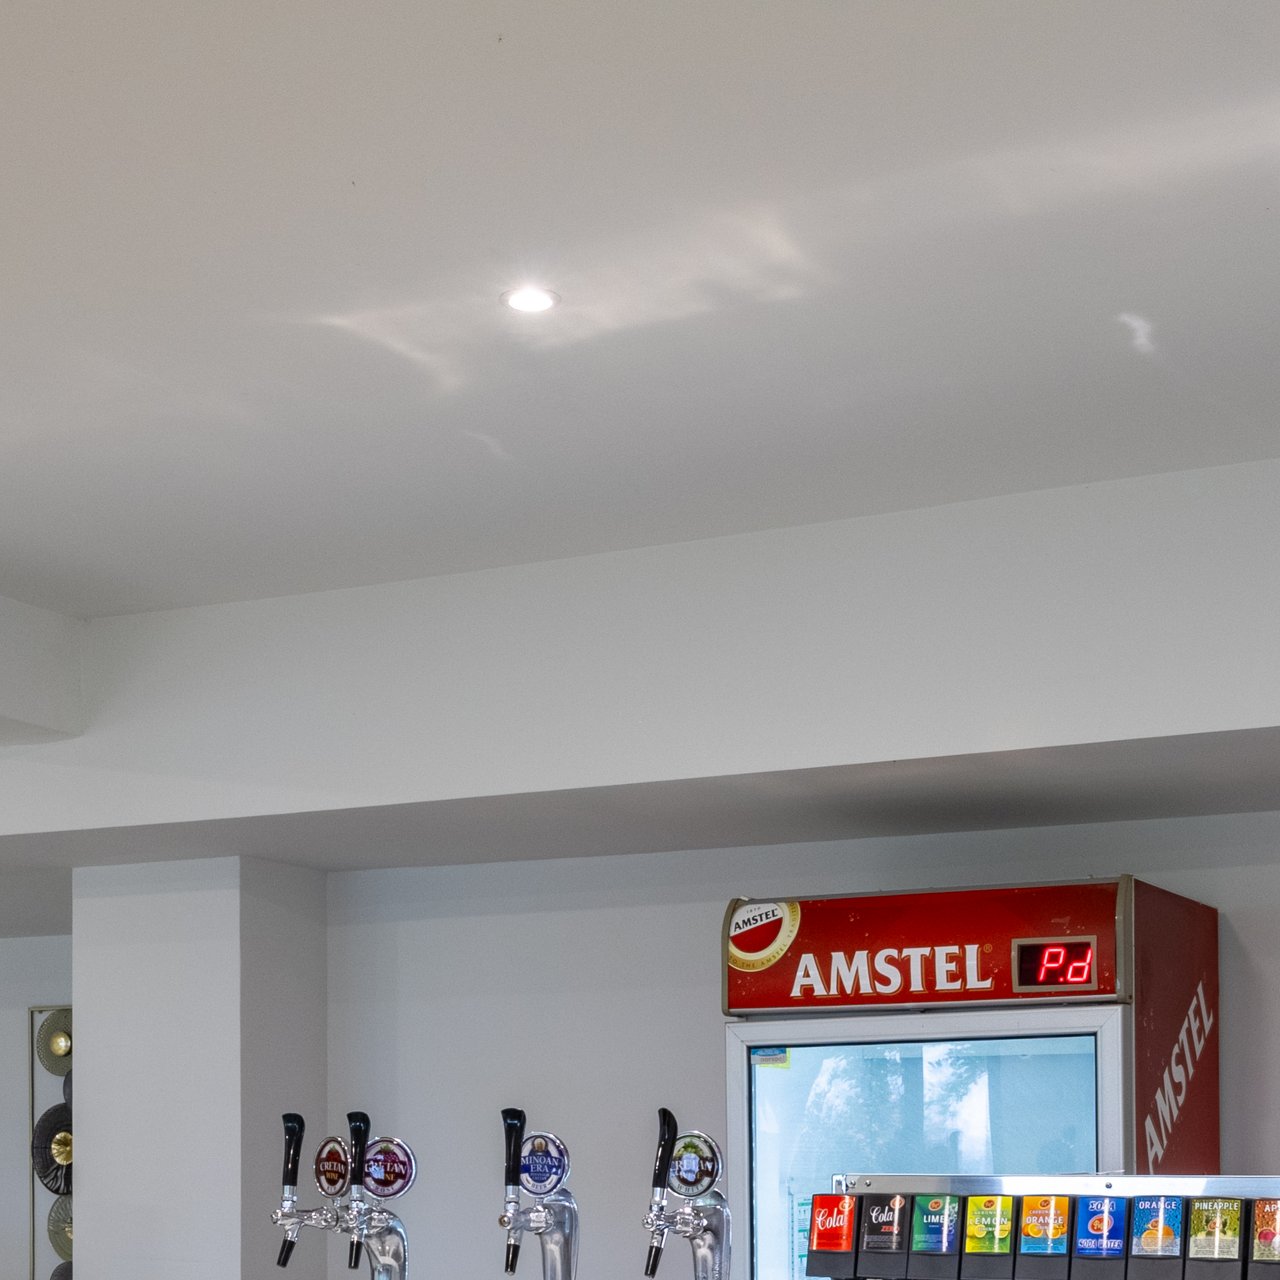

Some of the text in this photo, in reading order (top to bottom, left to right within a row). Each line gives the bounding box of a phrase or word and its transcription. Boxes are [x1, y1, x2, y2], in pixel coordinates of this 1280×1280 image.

[734, 909, 778, 932] AMSTEL
[790, 944, 993, 998] AMSTEL
[1145, 980, 1214, 1175] AMSTEL
[521, 1156, 559, 1166] MINOAN
[320, 1161, 345, 1174] CRETAN
[530, 1164, 549, 1172] ERA
[326, 1172, 339, 1180] WINE
[1194, 1202, 1239, 1210] PINEAPPLE
[815, 1208, 845, 1230] Cola
[870, 1205, 893, 1224] Cola
[923, 1214, 945, 1223] LIME
[1025, 1216, 1064, 1224] ORANGE
[1078, 1239, 1097, 1248] SODA
